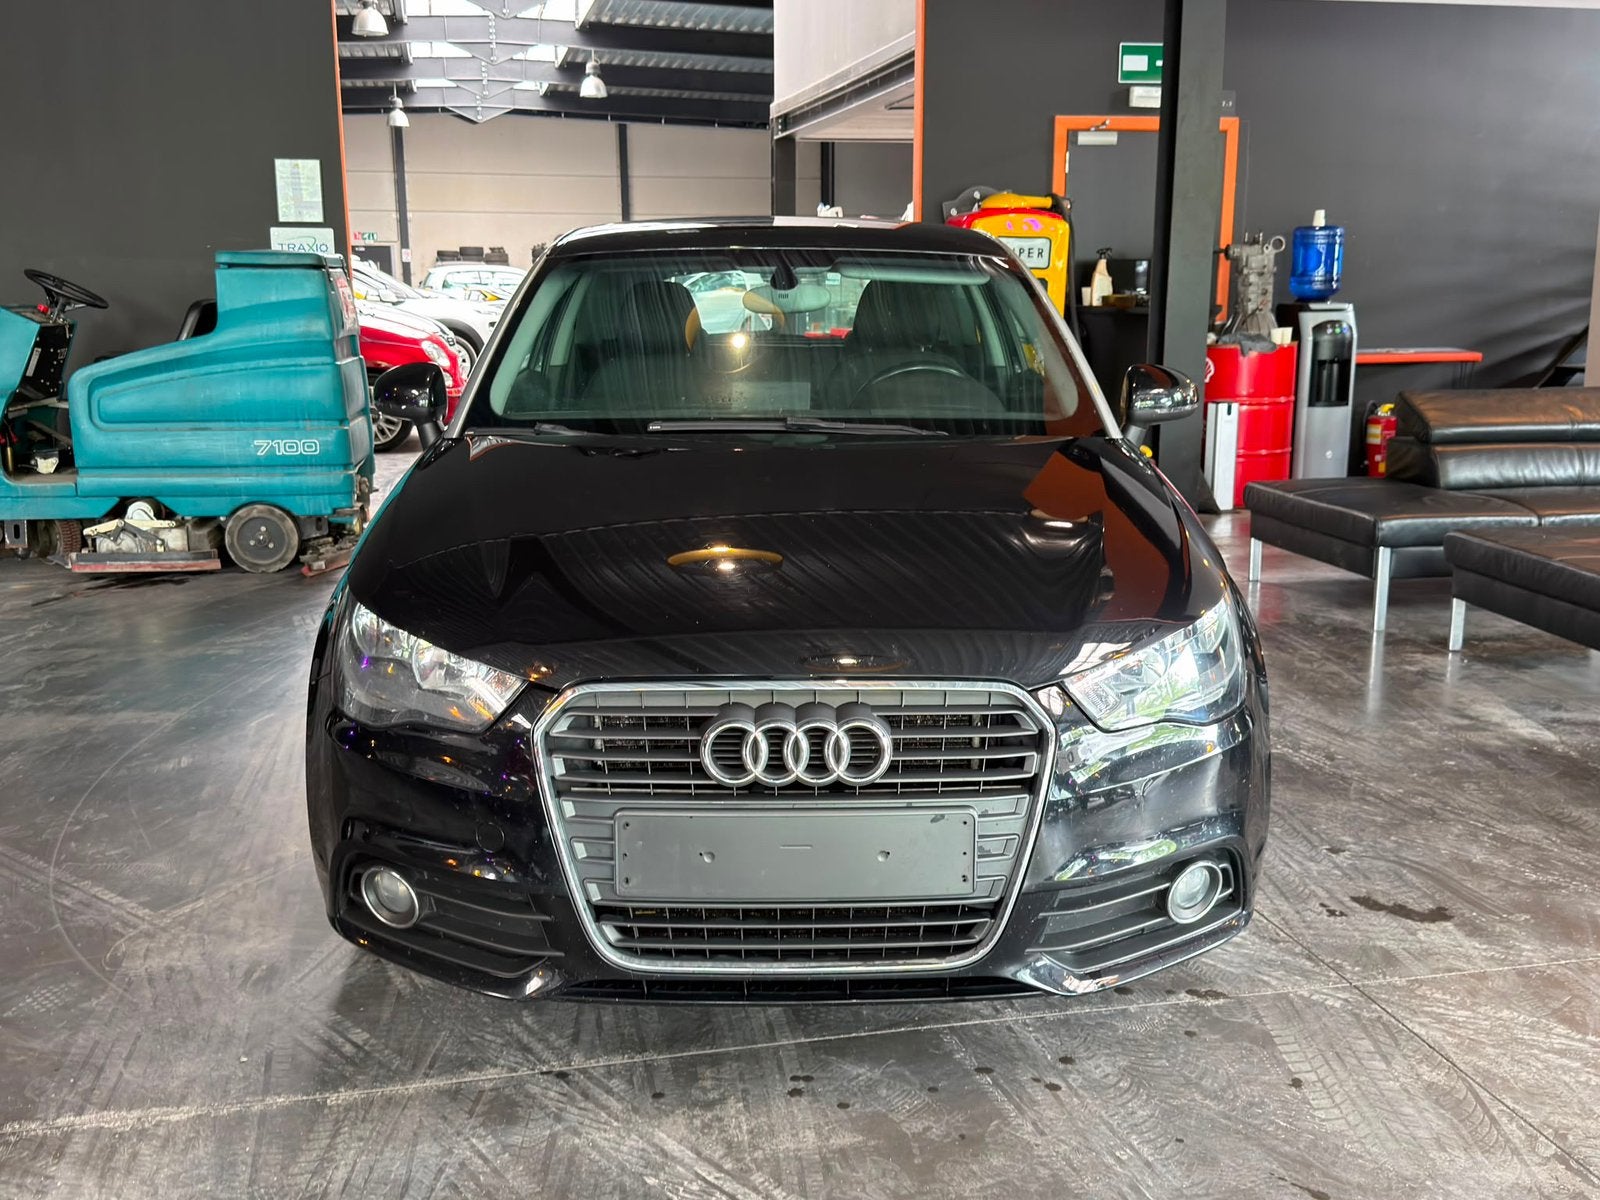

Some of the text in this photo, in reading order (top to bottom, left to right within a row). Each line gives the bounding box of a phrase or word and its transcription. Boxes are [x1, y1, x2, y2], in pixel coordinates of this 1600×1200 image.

[277, 243, 329, 253] TRAXIO
[1012, 247, 1044, 258] PER
[254, 439, 320, 455] 7100
